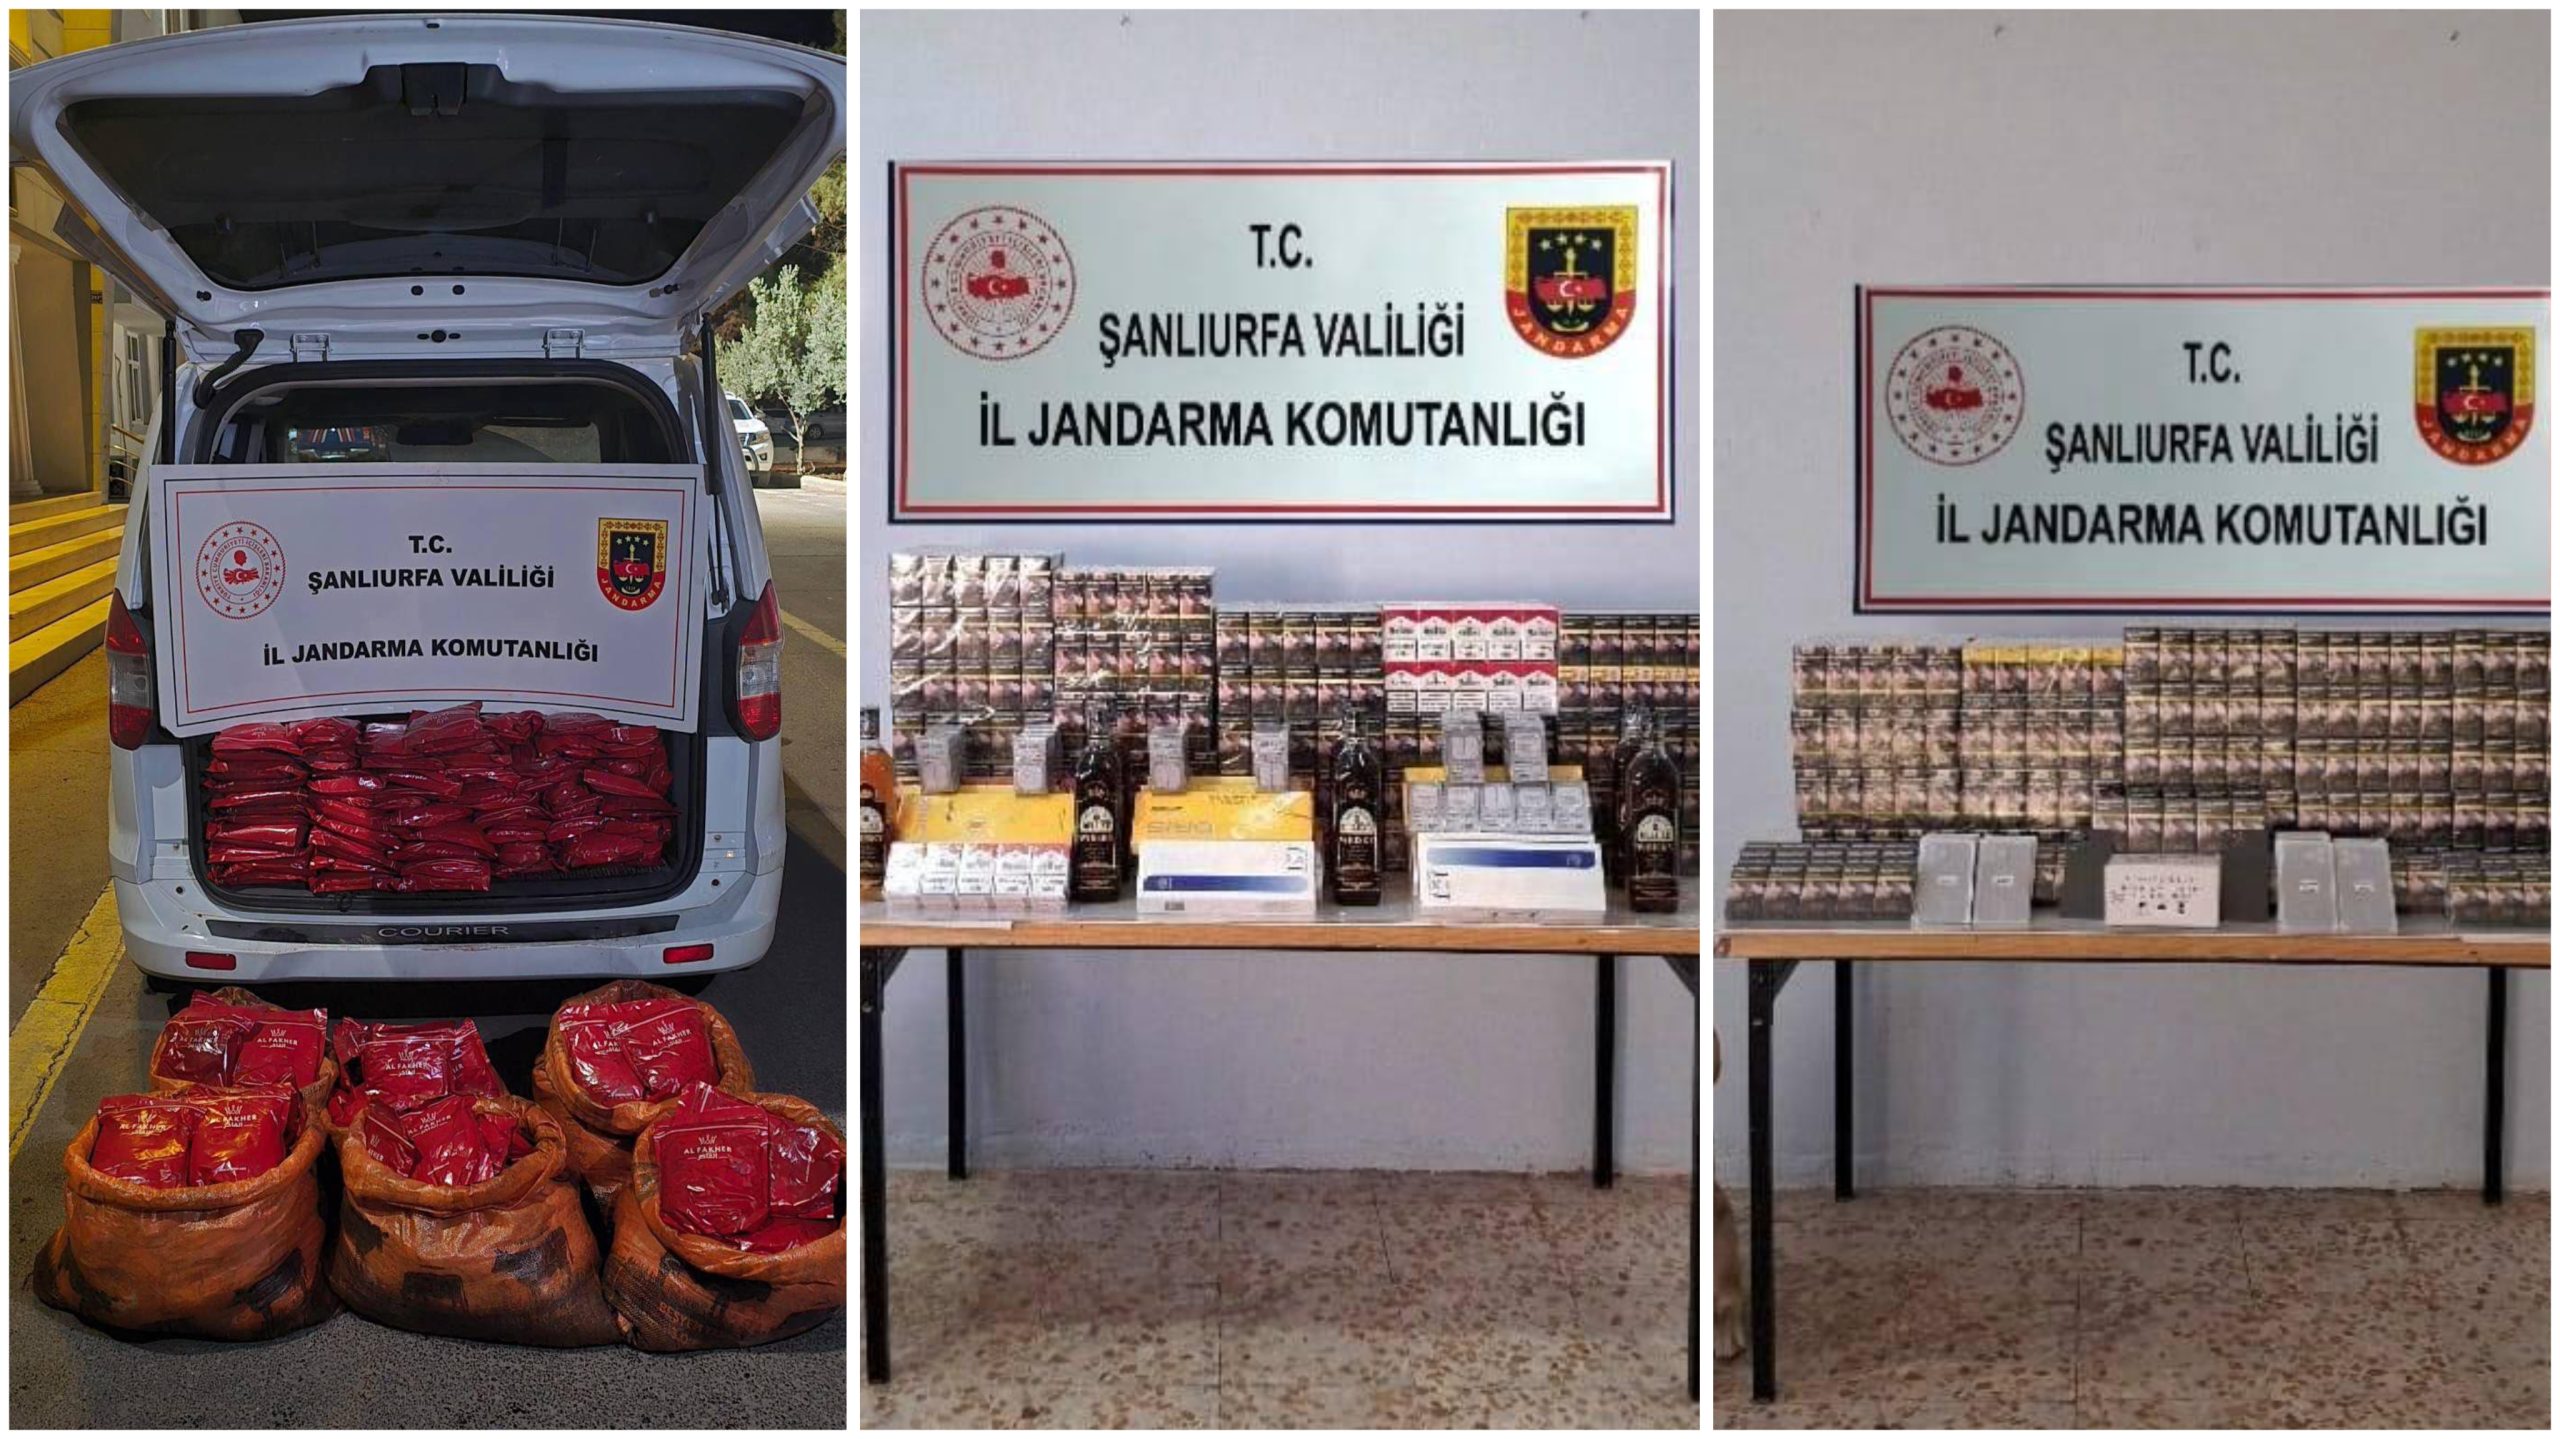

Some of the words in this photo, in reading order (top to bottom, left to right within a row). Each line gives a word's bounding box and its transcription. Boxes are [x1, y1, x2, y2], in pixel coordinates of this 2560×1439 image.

[1249, 223, 1313, 268] T.C.
[1099, 312, 1306, 369] ŞANLIURFA
[1314, 302, 1464, 358] VALİLİĞİ
[1514, 309, 1629, 352] JANDARMA
[2183, 341, 2240, 383] T.C.
[980, 390, 1016, 447] İL
[1028, 401, 1275, 447] JANDARMA
[1287, 391, 1585, 446] KOMUTANLIĞI
[2045, 422, 2234, 474] ŞANLIURFA
[2241, 413, 2378, 464] VALİLİĞİ
[1937, 493, 1971, 544] İL
[1981, 503, 2204, 545] JANDARMA
[2216, 496, 2487, 546] KOMUTANLIĞI
[408, 534, 453, 554] T.C.
[308, 568, 444, 595] ŞANLIURFA
[450, 564, 555, 588] VALİLİĞİ
[600, 578, 661, 607] JANDARMA
[263, 643, 285, 666] İL
[291, 639, 424, 664] JANDARMA
[431, 638, 598, 662] KOMUTANLIĞI
[378, 925, 509, 938] COURIER
[696, 1145, 732, 1153] FAKHER
